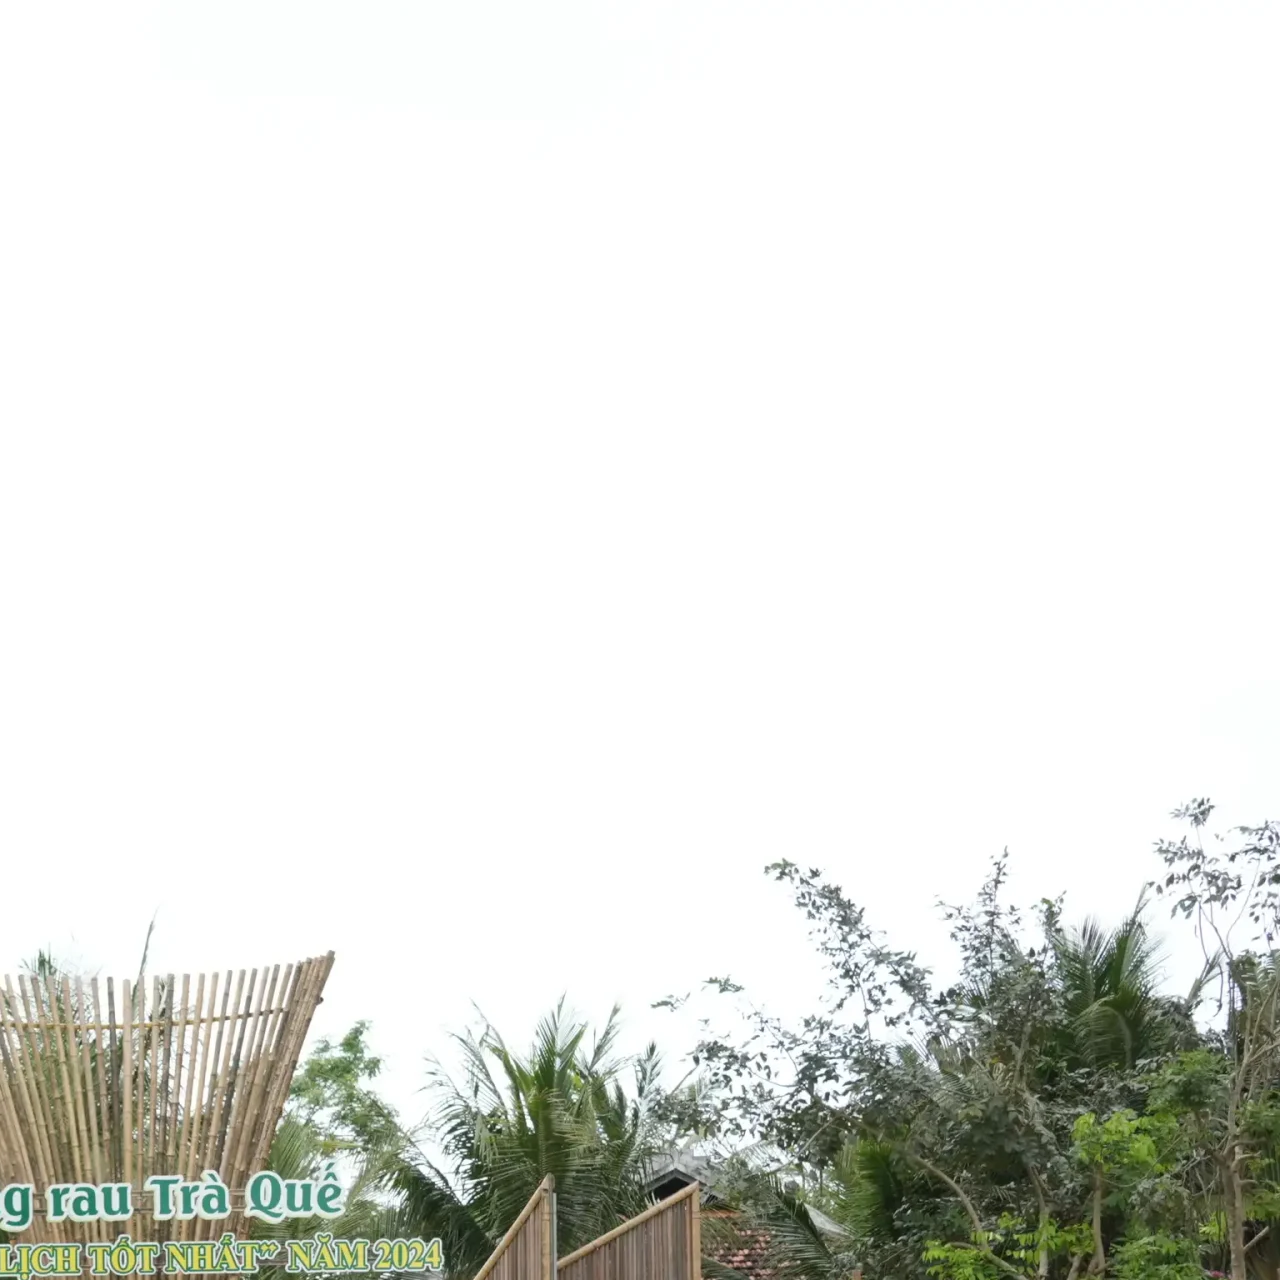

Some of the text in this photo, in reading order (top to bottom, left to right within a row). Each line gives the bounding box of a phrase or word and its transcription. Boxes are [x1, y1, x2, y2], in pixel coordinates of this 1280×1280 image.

[50, 1182, 132, 1220] rau
[149, 1173, 229, 1217] Trà
[249, 1160, 344, 1219] Quế
[89, 1236, 158, 1274] TỐT
[288, 1234, 370, 1270] NĂM
[373, 1239, 443, 1270] 2024
